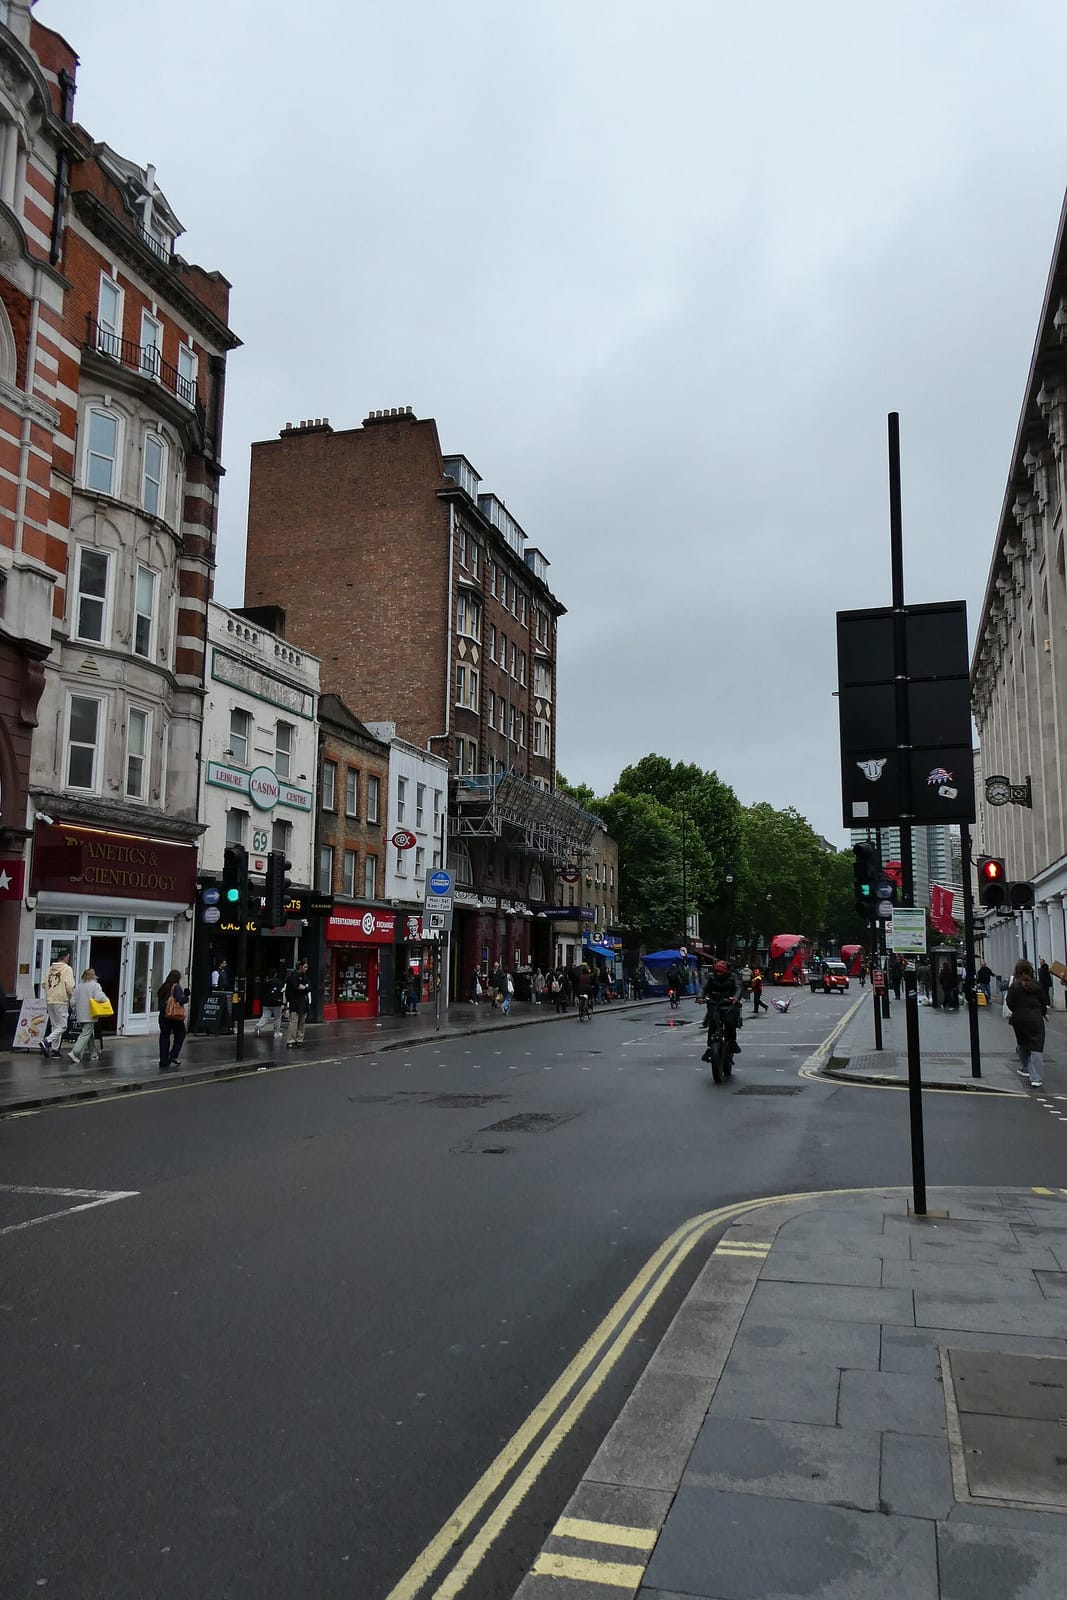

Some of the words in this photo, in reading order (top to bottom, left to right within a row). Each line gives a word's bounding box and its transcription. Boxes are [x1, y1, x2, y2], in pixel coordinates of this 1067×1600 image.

[215, 769, 243, 786] LEISURE
[251, 779, 280, 796] CASINO
[285, 792, 307, 805] CENTRE
[253, 831, 268, 852] 69
[149, 851, 159, 866] &
[69, 865, 177, 890] CIENTOLOGY
[99, 919, 113, 929] 68
[220, 921, 257, 931] CASNO
